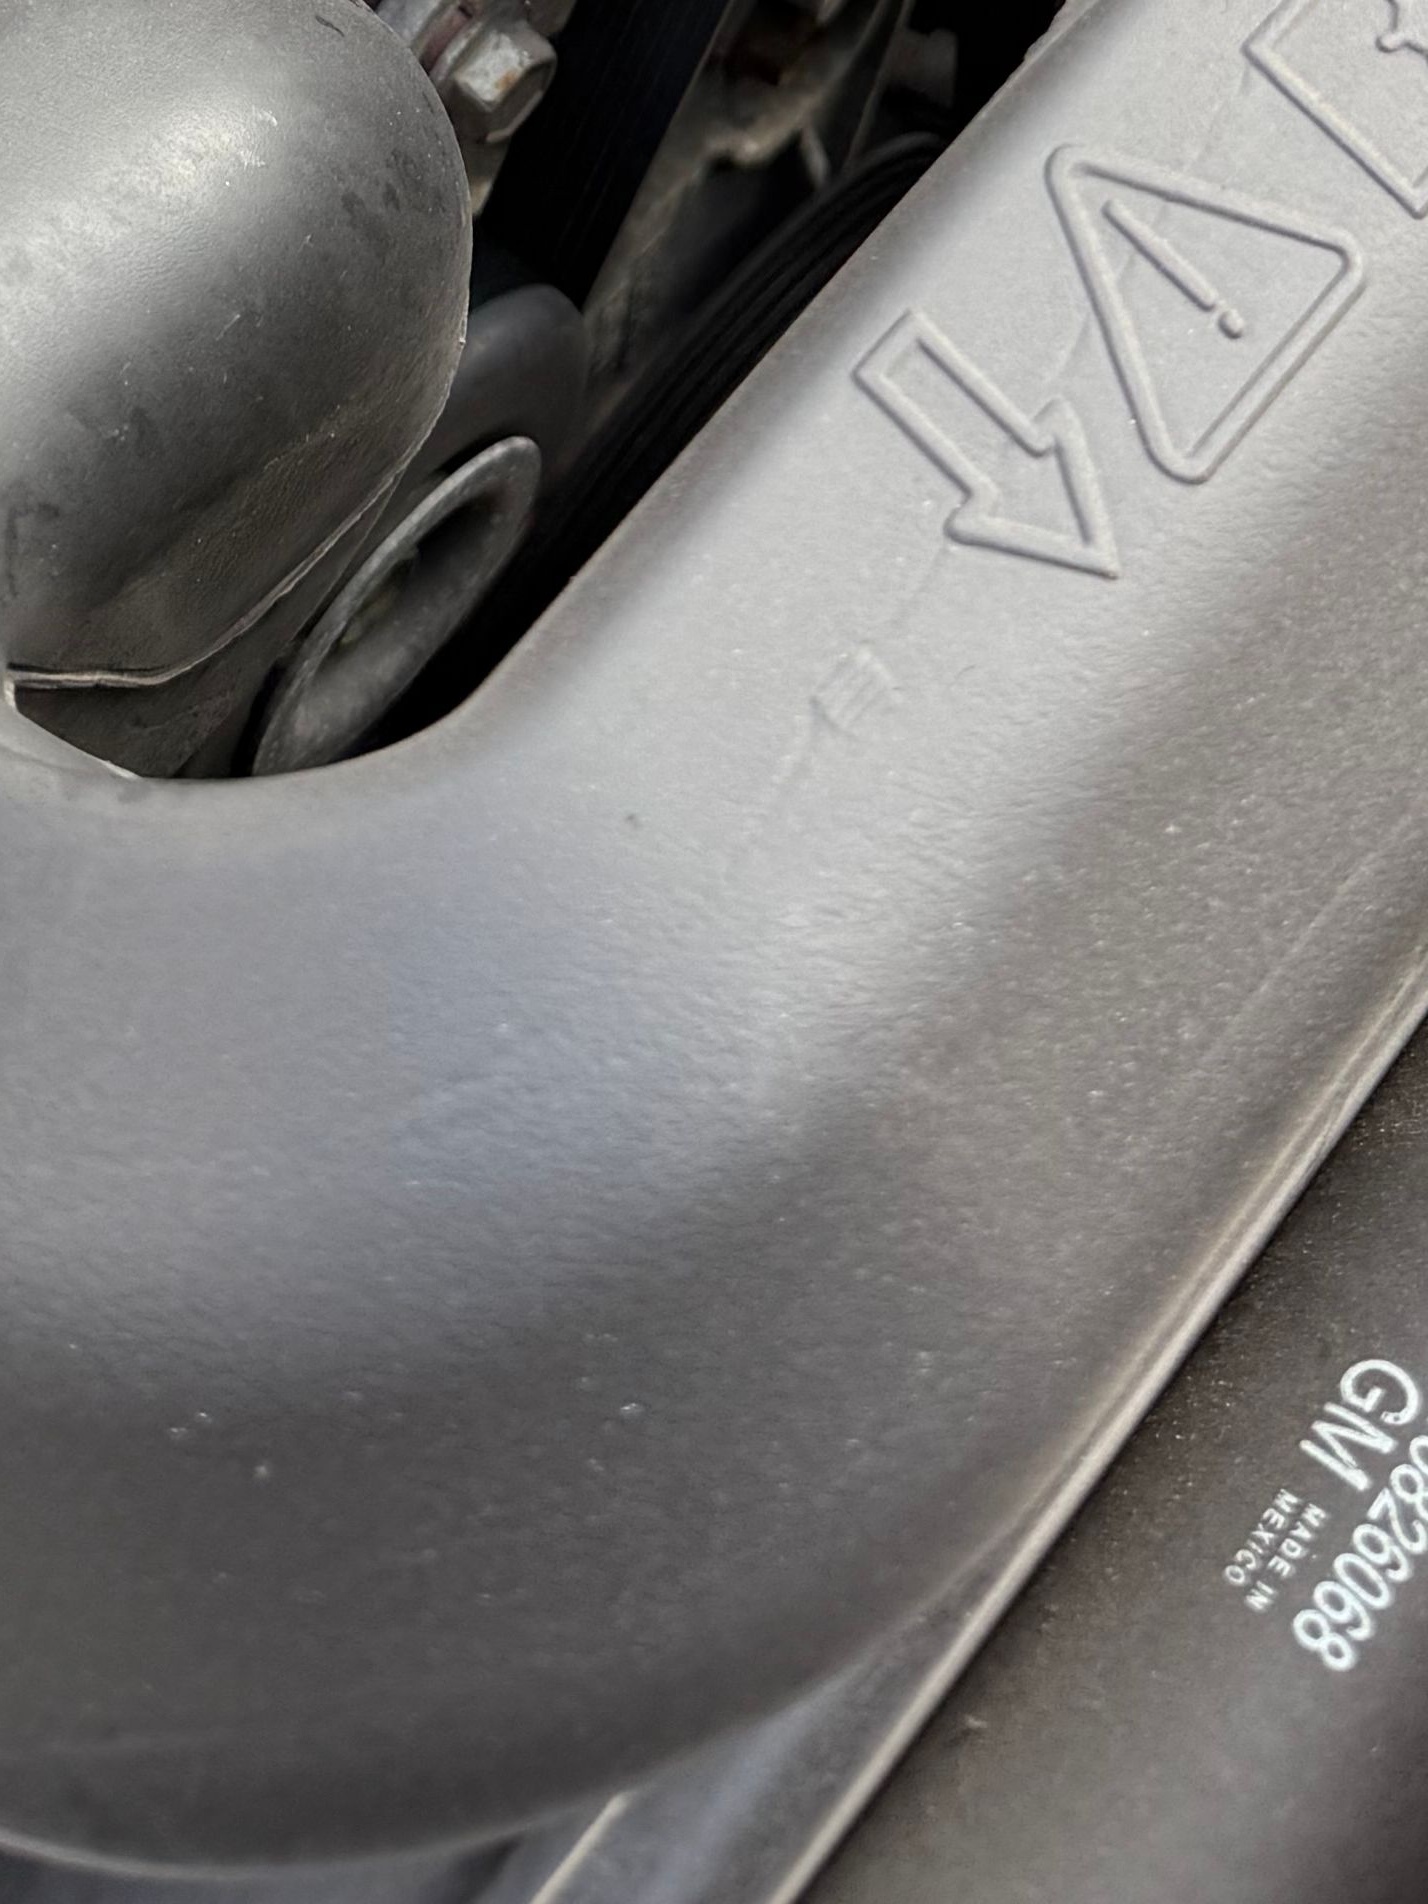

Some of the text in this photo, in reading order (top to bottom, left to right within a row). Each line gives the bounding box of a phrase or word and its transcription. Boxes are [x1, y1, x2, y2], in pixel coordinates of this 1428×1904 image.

[1299, 1358, 1421, 1491] GM
[1223, 1488, 1302, 1587] MEXICO
[1245, 1503, 1328, 1612] MADE IN
